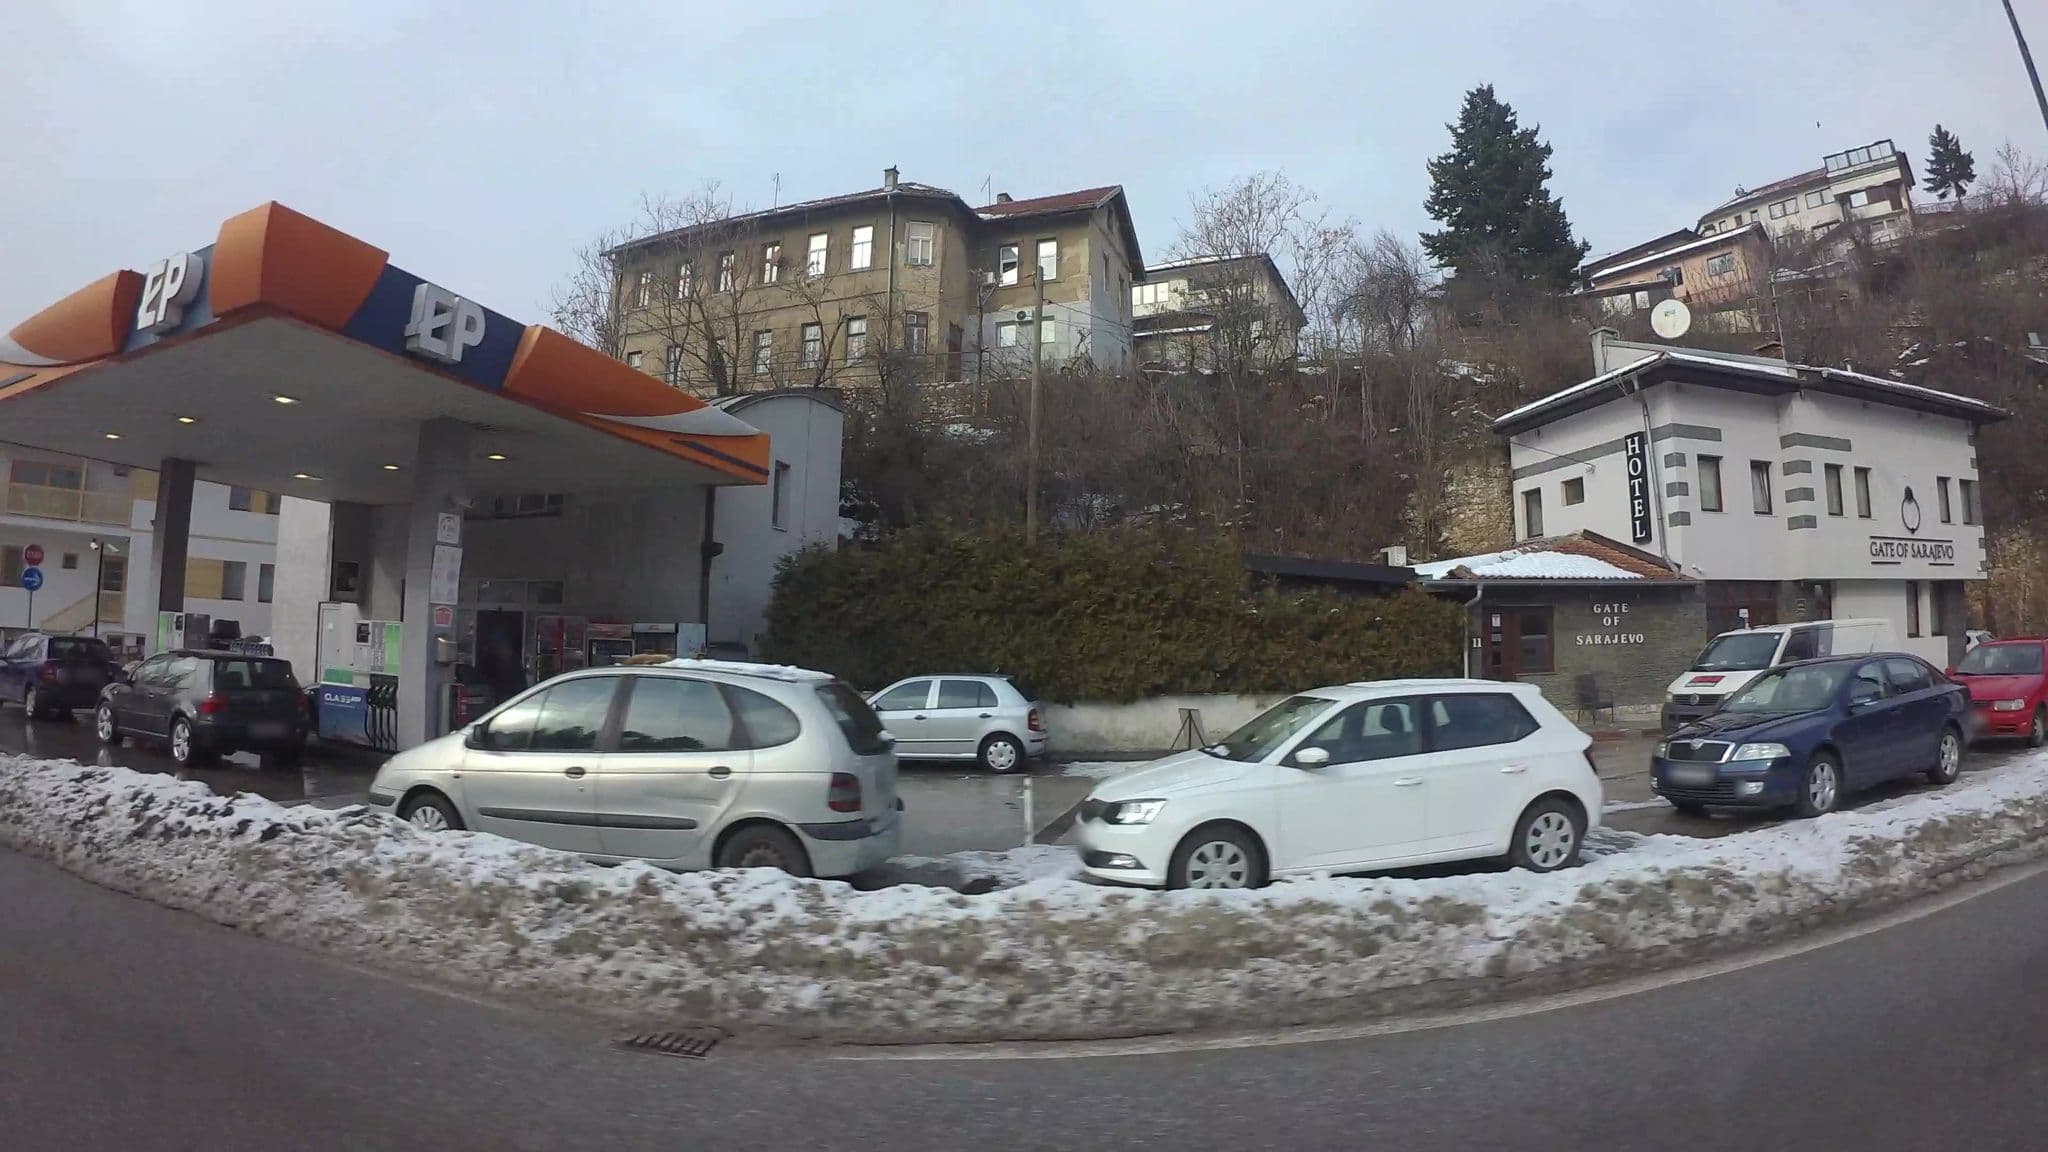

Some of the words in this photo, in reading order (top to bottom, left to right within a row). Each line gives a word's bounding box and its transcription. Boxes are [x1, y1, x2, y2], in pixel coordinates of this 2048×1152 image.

[1626, 436, 1646, 539] HOTEL
[1869, 541, 1895, 558] GATE
[1896, 542, 1909, 558] OF
[1911, 543, 1954, 561] SARAJEVO
[1593, 603, 1629, 614] GATE
[1603, 616, 1621, 627] OF
[1472, 637, 1482, 648] 11
[1575, 633, 1644, 646] SARAJEVO
